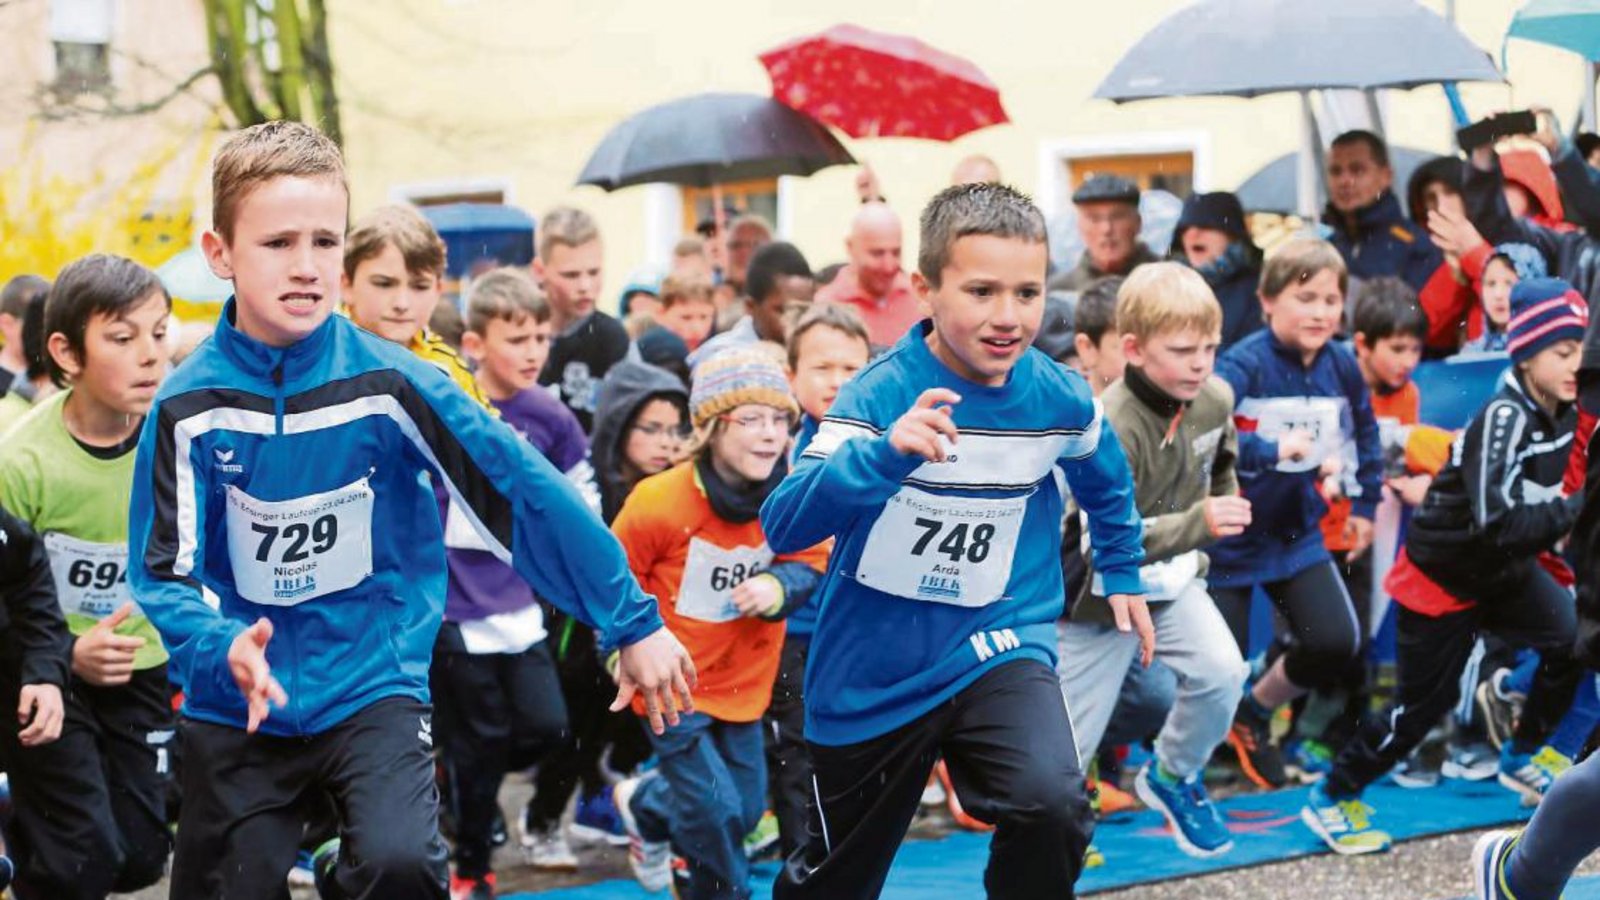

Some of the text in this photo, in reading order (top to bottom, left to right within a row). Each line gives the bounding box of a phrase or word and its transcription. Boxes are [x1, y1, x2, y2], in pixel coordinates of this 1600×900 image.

[240, 502, 279, 521] Ensinger
[281, 507, 320, 520] Laufcup
[251, 514, 338, 563] 729
[911, 517, 996, 564] 748
[274, 561, 318, 576] Nicolas
[932, 564, 960, 576] Arda
[969, 628, 1021, 662] KM
